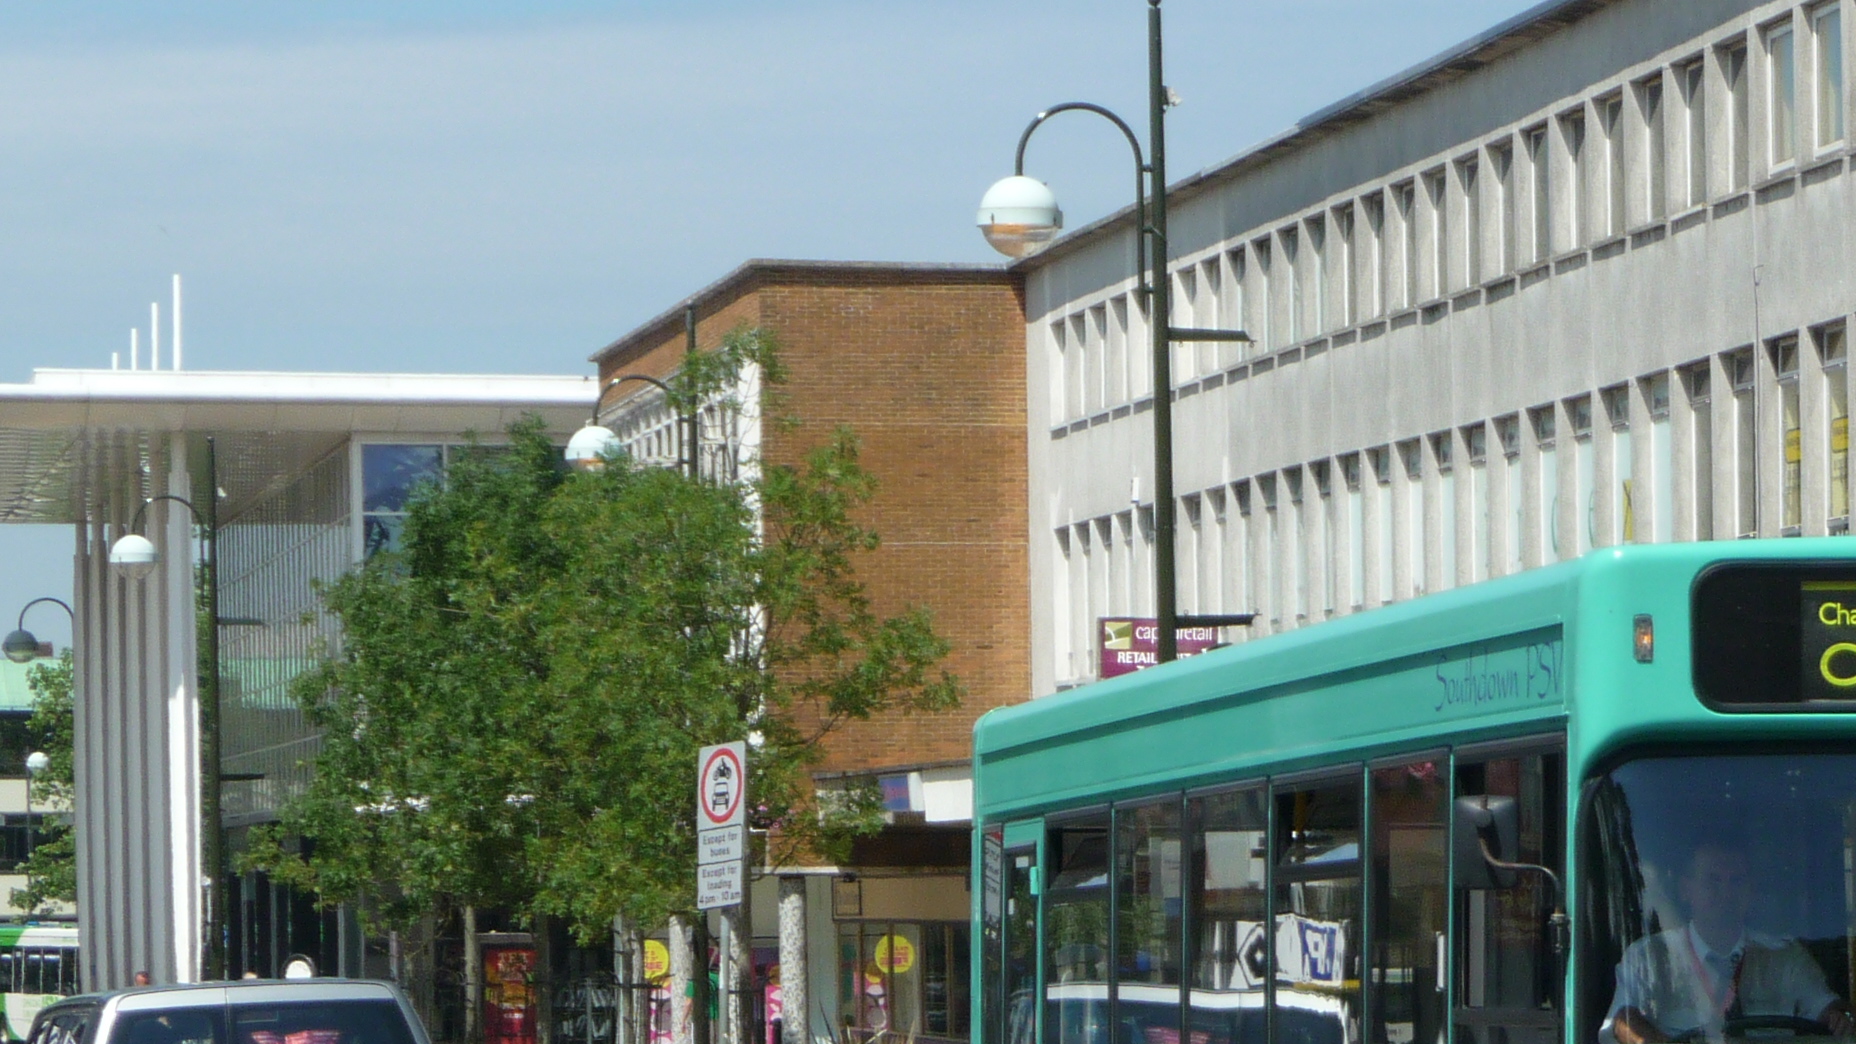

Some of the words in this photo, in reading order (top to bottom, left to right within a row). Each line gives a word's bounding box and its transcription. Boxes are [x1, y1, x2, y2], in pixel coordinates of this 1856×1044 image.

[1117, 651, 1158, 664] RETAIL
[1435, 646, 1519, 712] Southdown
[1527, 641, 1564, 699] PSV
[702, 867, 725, 880] Except
